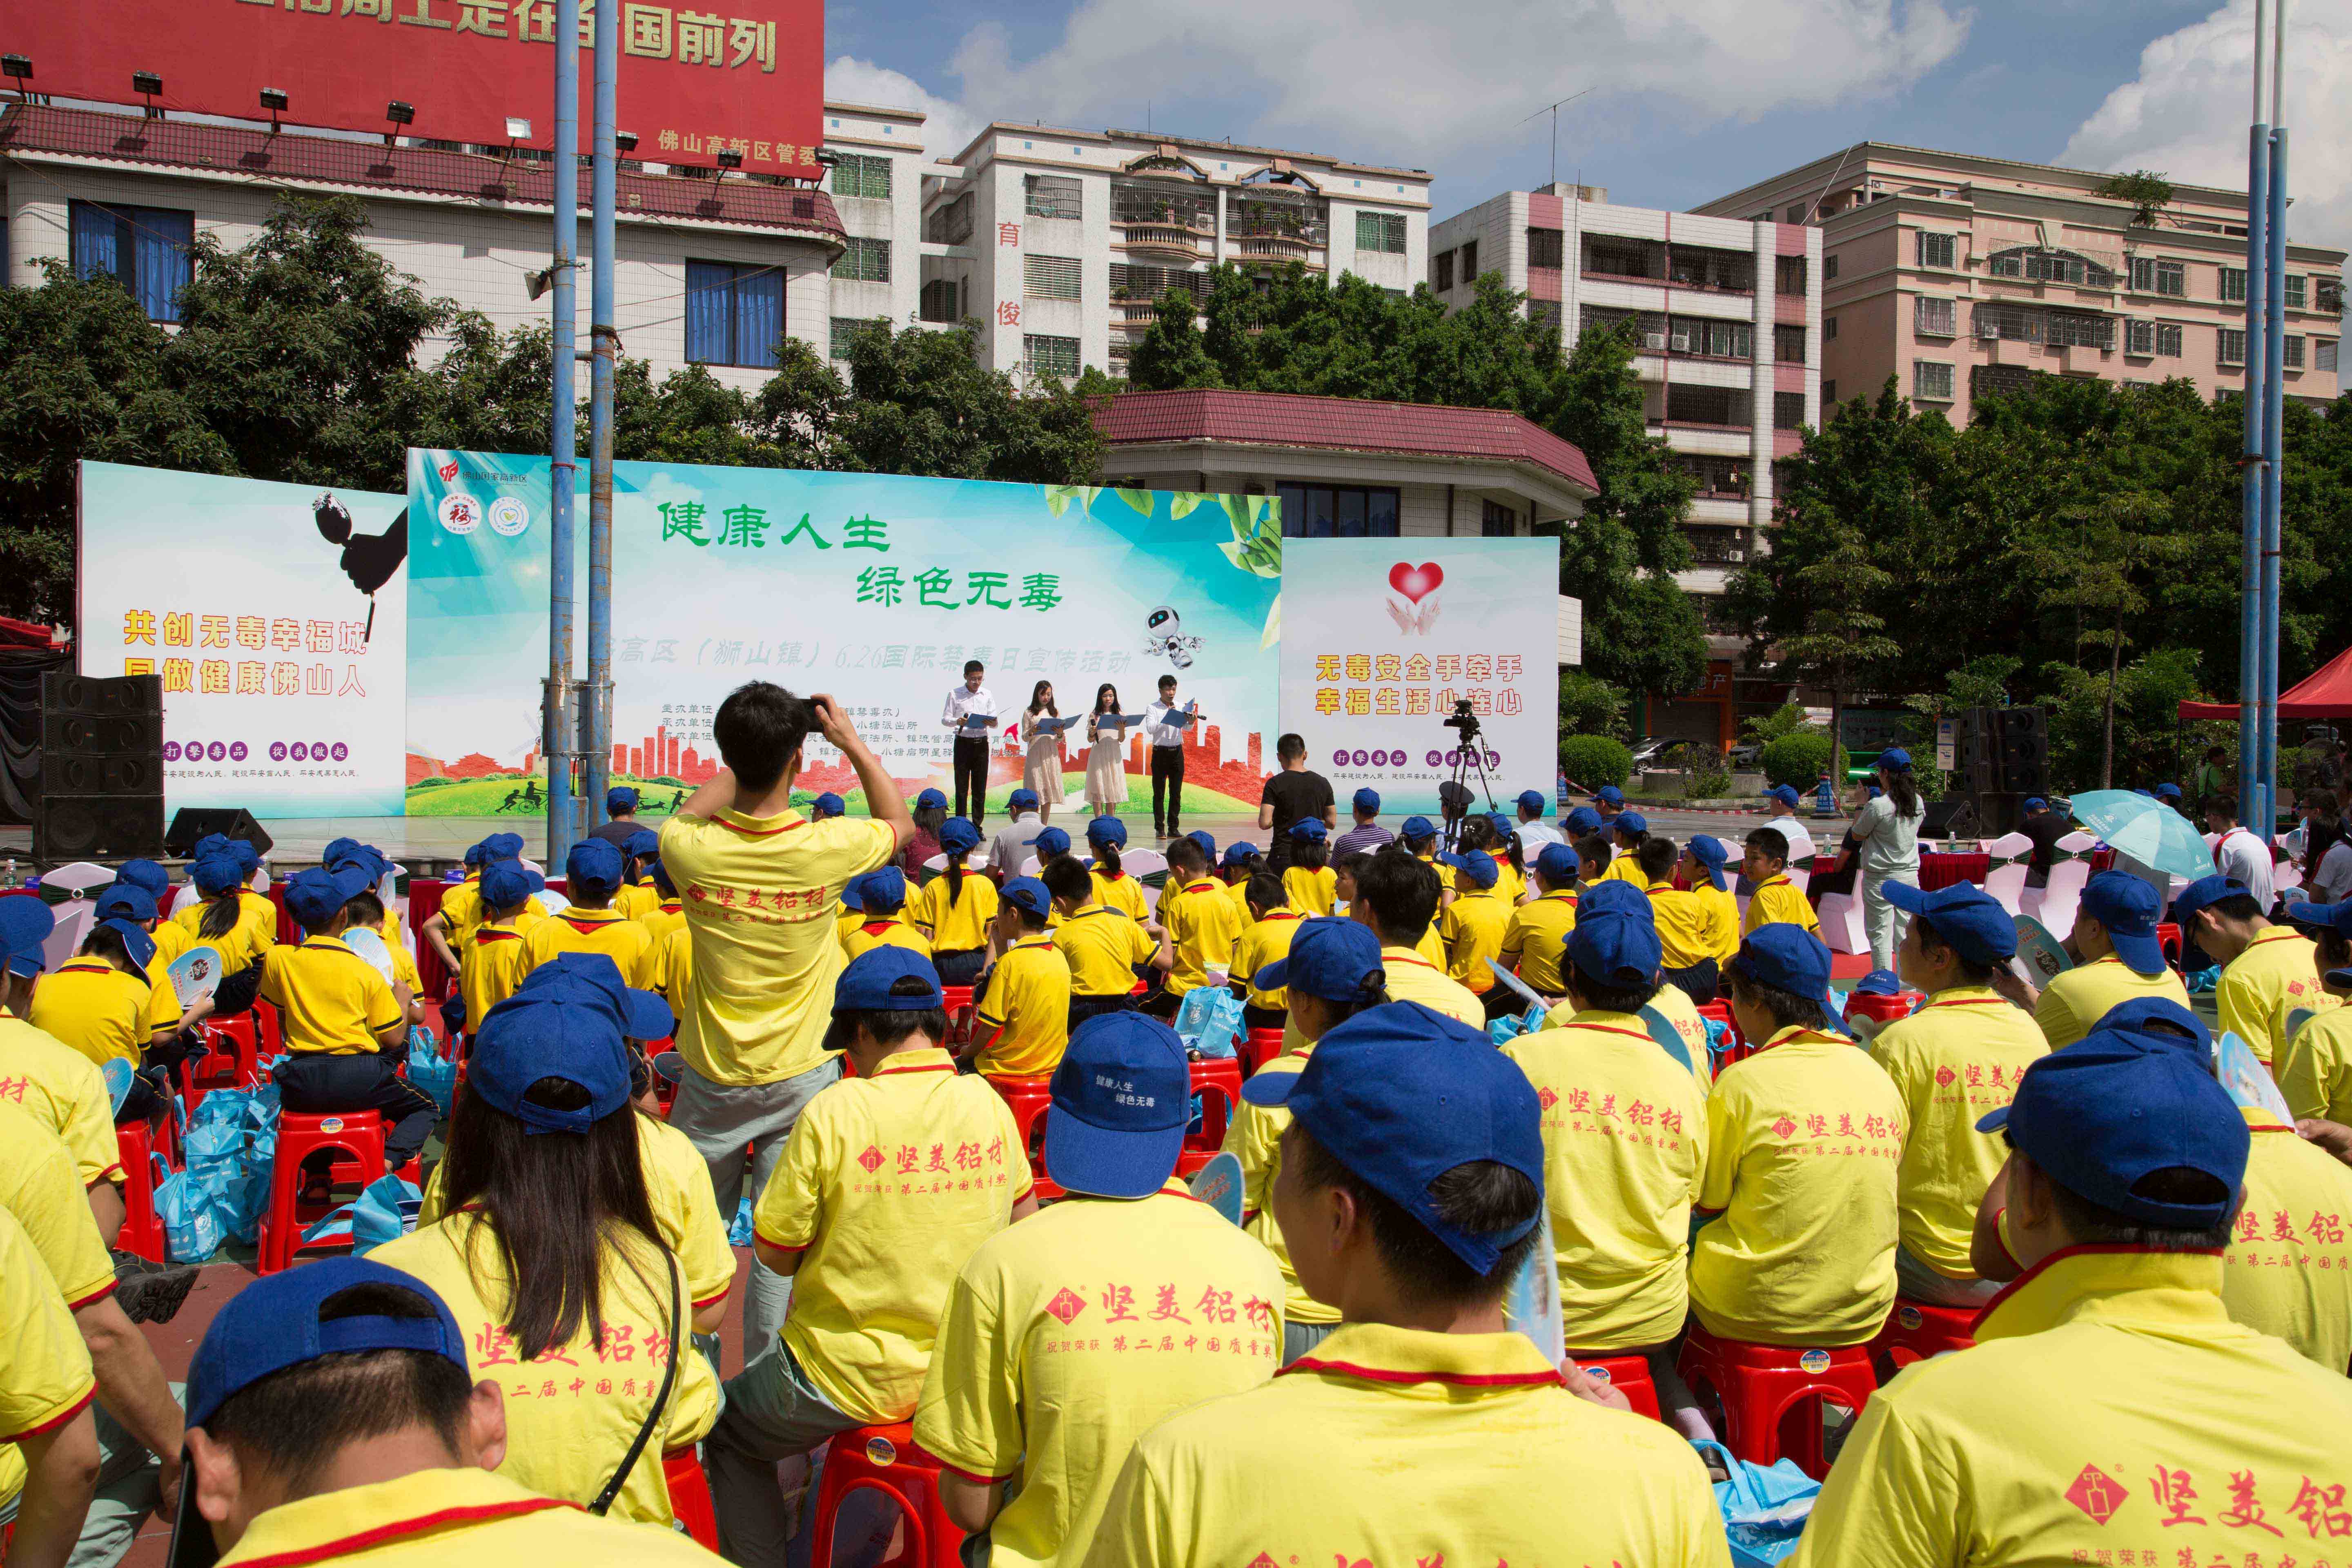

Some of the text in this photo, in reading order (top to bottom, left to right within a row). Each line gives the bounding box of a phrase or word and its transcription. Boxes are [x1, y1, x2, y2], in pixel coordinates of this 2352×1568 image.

[462, 471, 527, 482] 佛山国家高新区
[657, 501, 891, 552] 健康人生
[856, 566, 1062, 612] 绿色无毒
[124, 608, 366, 655] 共创无毒幸福城
[1316, 654, 1522, 682] 无毒安全手牵手
[1316, 688, 1522, 715] 幸福生活心连心
[166, 745, 345, 758] 打擊毒品 從我做起
[1336, 753, 1403, 763] 打擊毒品
[716, 885, 826, 911] 坚美铝材
[1096, 1074, 1134, 1092] 健康人生
[1115, 1092, 1155, 1107] 绿色无毒
[1568, 1087, 1683, 1134] 坚美铝材
[1806, 1111, 1903, 1144] 坚美铝材
[897, 1136, 1003, 1175] 坚美铝材
[1815, 1145, 1902, 1159] 第二届中国质量
[901, 1172, 1007, 1196] 第二届中国质奖
[2235, 1209, 2352, 1245] 坚美铝
[1101, 1283, 1273, 1333] 坚美铝材
[1047, 1334, 1272, 1359] 祝贺荣获 第二届中国质量奖
[2148, 1463, 2352, 1538] 坚美铝
[2072, 1548, 2158, 1567] 祝贺荣获
